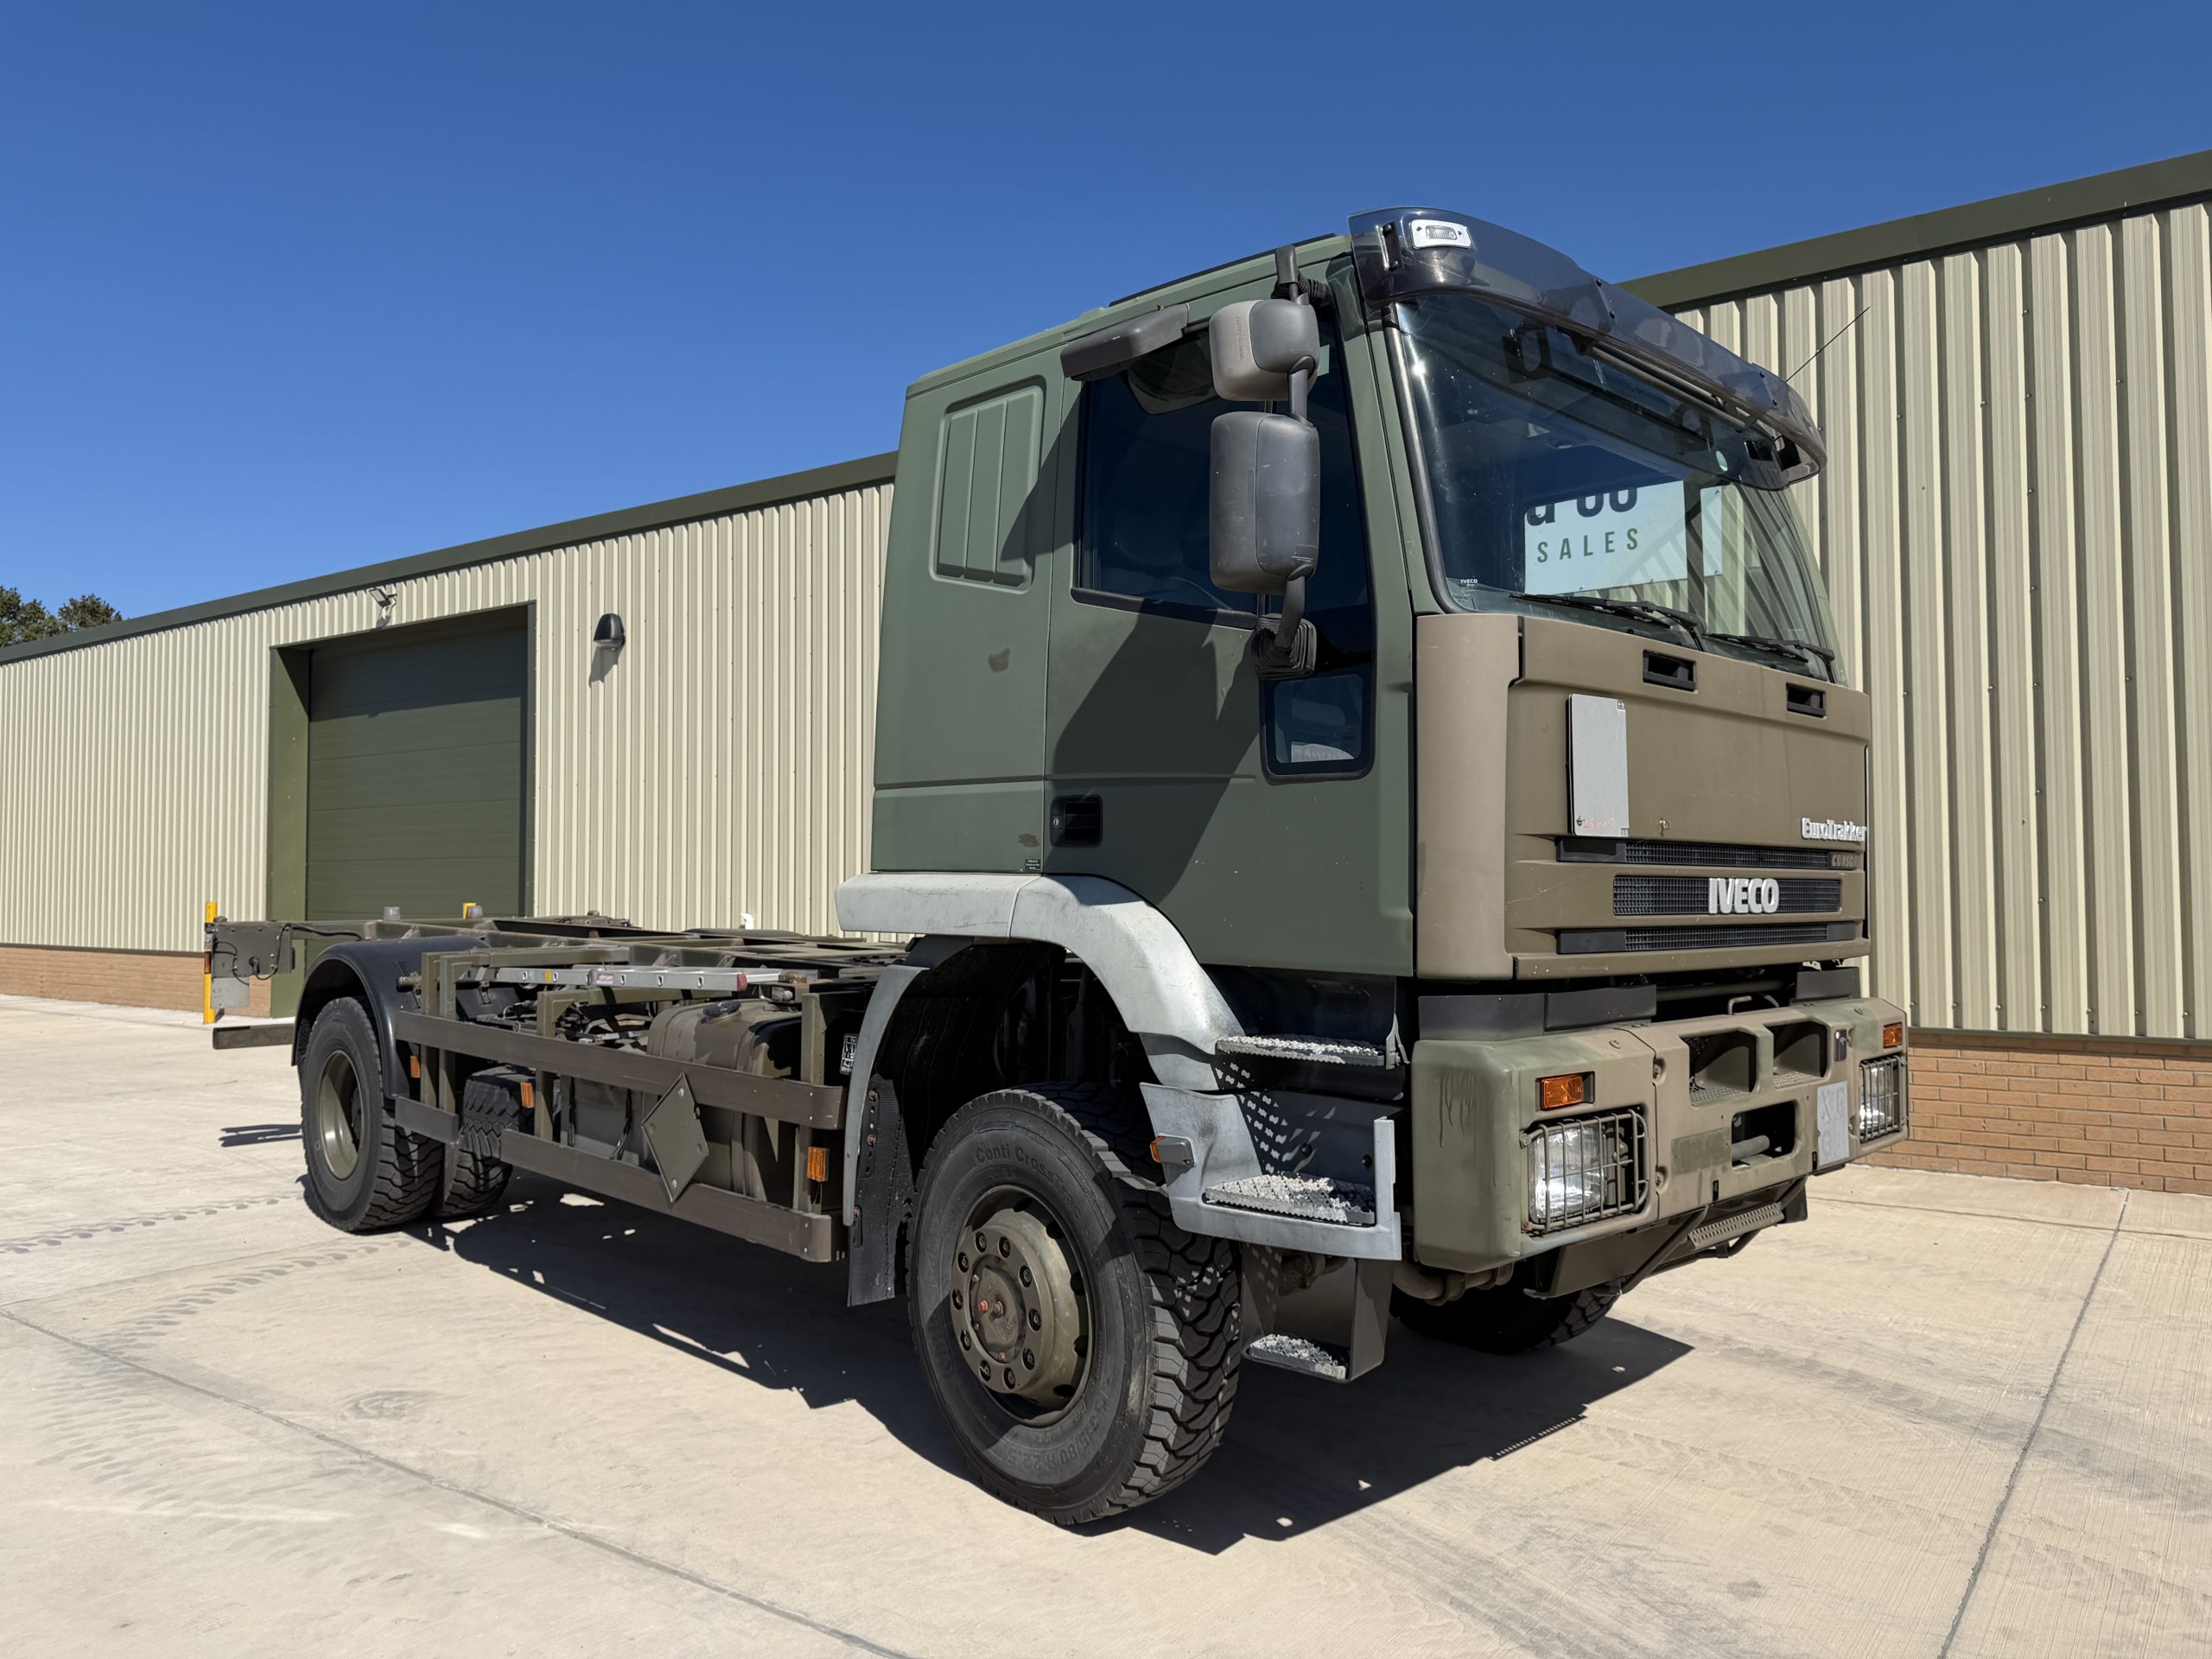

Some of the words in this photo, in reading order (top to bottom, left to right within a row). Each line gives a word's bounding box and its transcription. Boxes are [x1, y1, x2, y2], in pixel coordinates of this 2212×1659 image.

[1536, 527, 1638, 563] SALES
[1802, 817, 1866, 842] EuroTrakker
[1708, 877, 1780, 914] IVECO
[976, 1143, 1011, 1164] Conti
